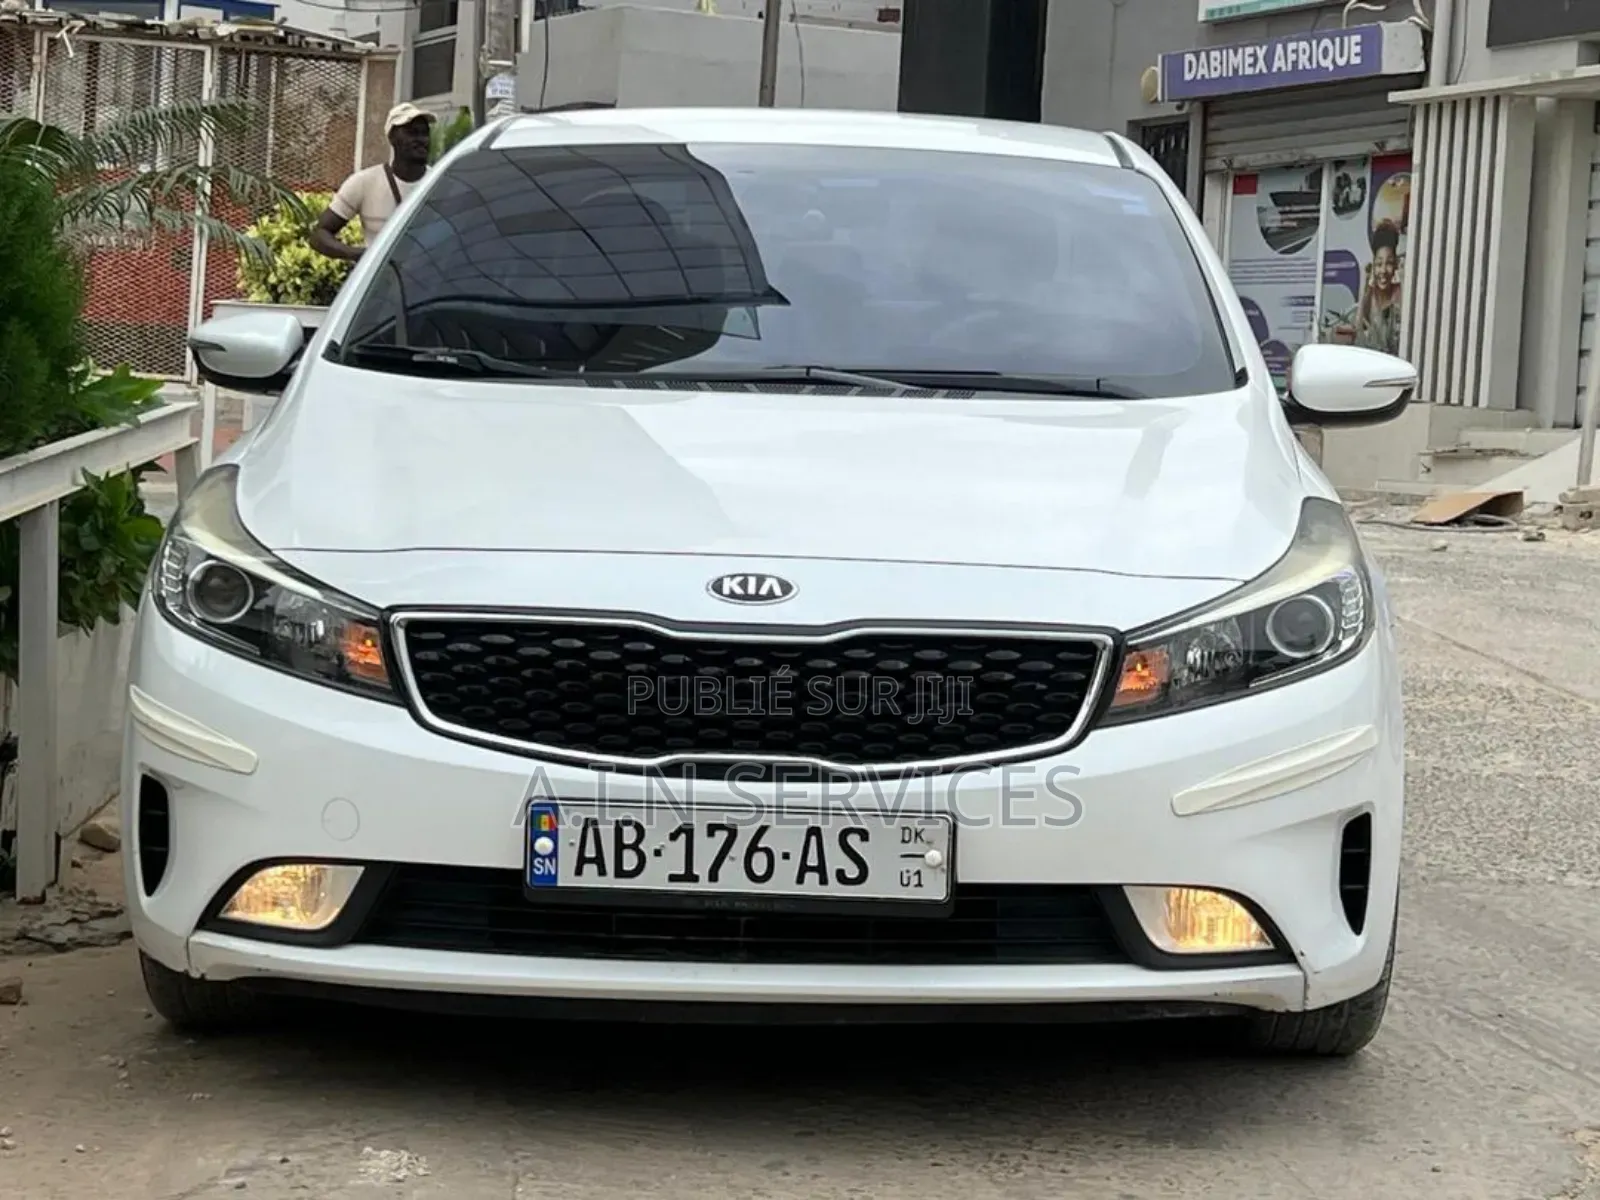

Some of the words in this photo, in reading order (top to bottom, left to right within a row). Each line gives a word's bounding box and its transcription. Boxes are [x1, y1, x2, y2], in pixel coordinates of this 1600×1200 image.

[1183, 45, 1269, 81] DABIMEX
[1271, 34, 1362, 73] AFRIQUE
[722, 576, 783, 597] KIA
[900, 826, 926, 844] DK
[533, 857, 556, 876] SN
